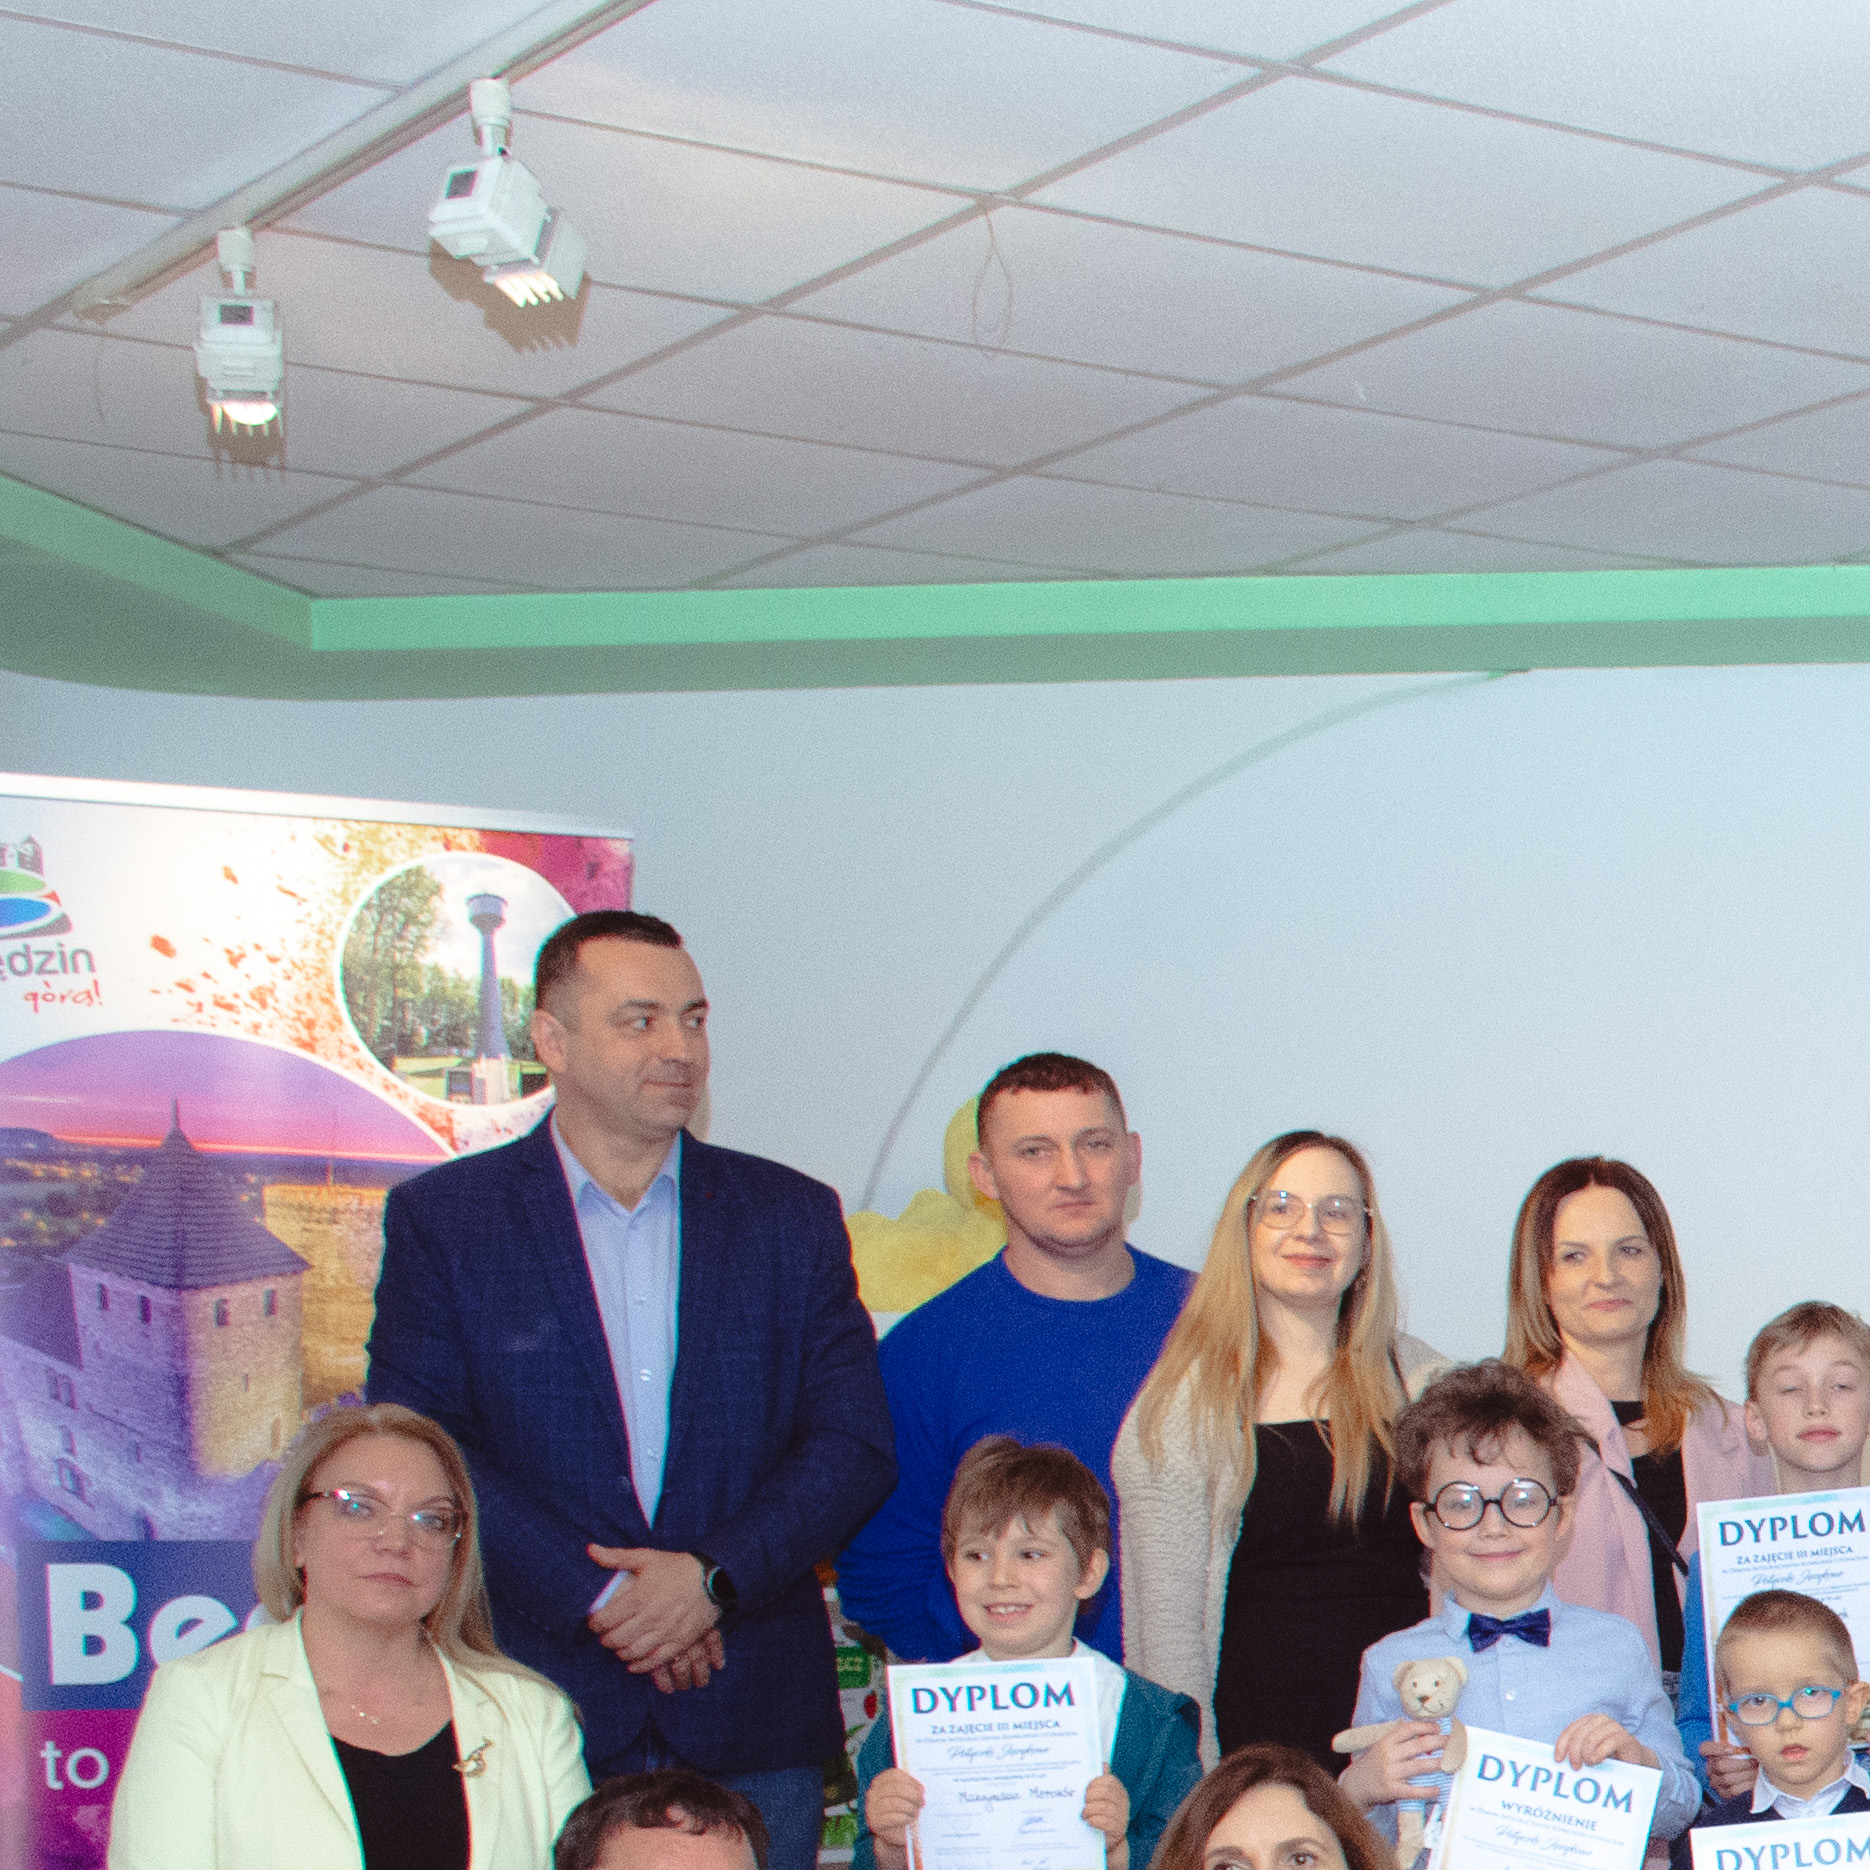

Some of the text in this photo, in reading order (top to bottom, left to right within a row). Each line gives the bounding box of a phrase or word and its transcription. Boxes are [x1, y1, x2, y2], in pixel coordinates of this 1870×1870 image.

[1719, 1508, 1866, 1546] DYPLOM
[46, 1563, 283, 1685] Be
[911, 1680, 1076, 1714] DYPLOM
[40, 1740, 110, 1790] to
[1476, 1753, 1634, 1814] DYPLOM
[1501, 1799, 1598, 1832] WYRÓŻNIENIE
